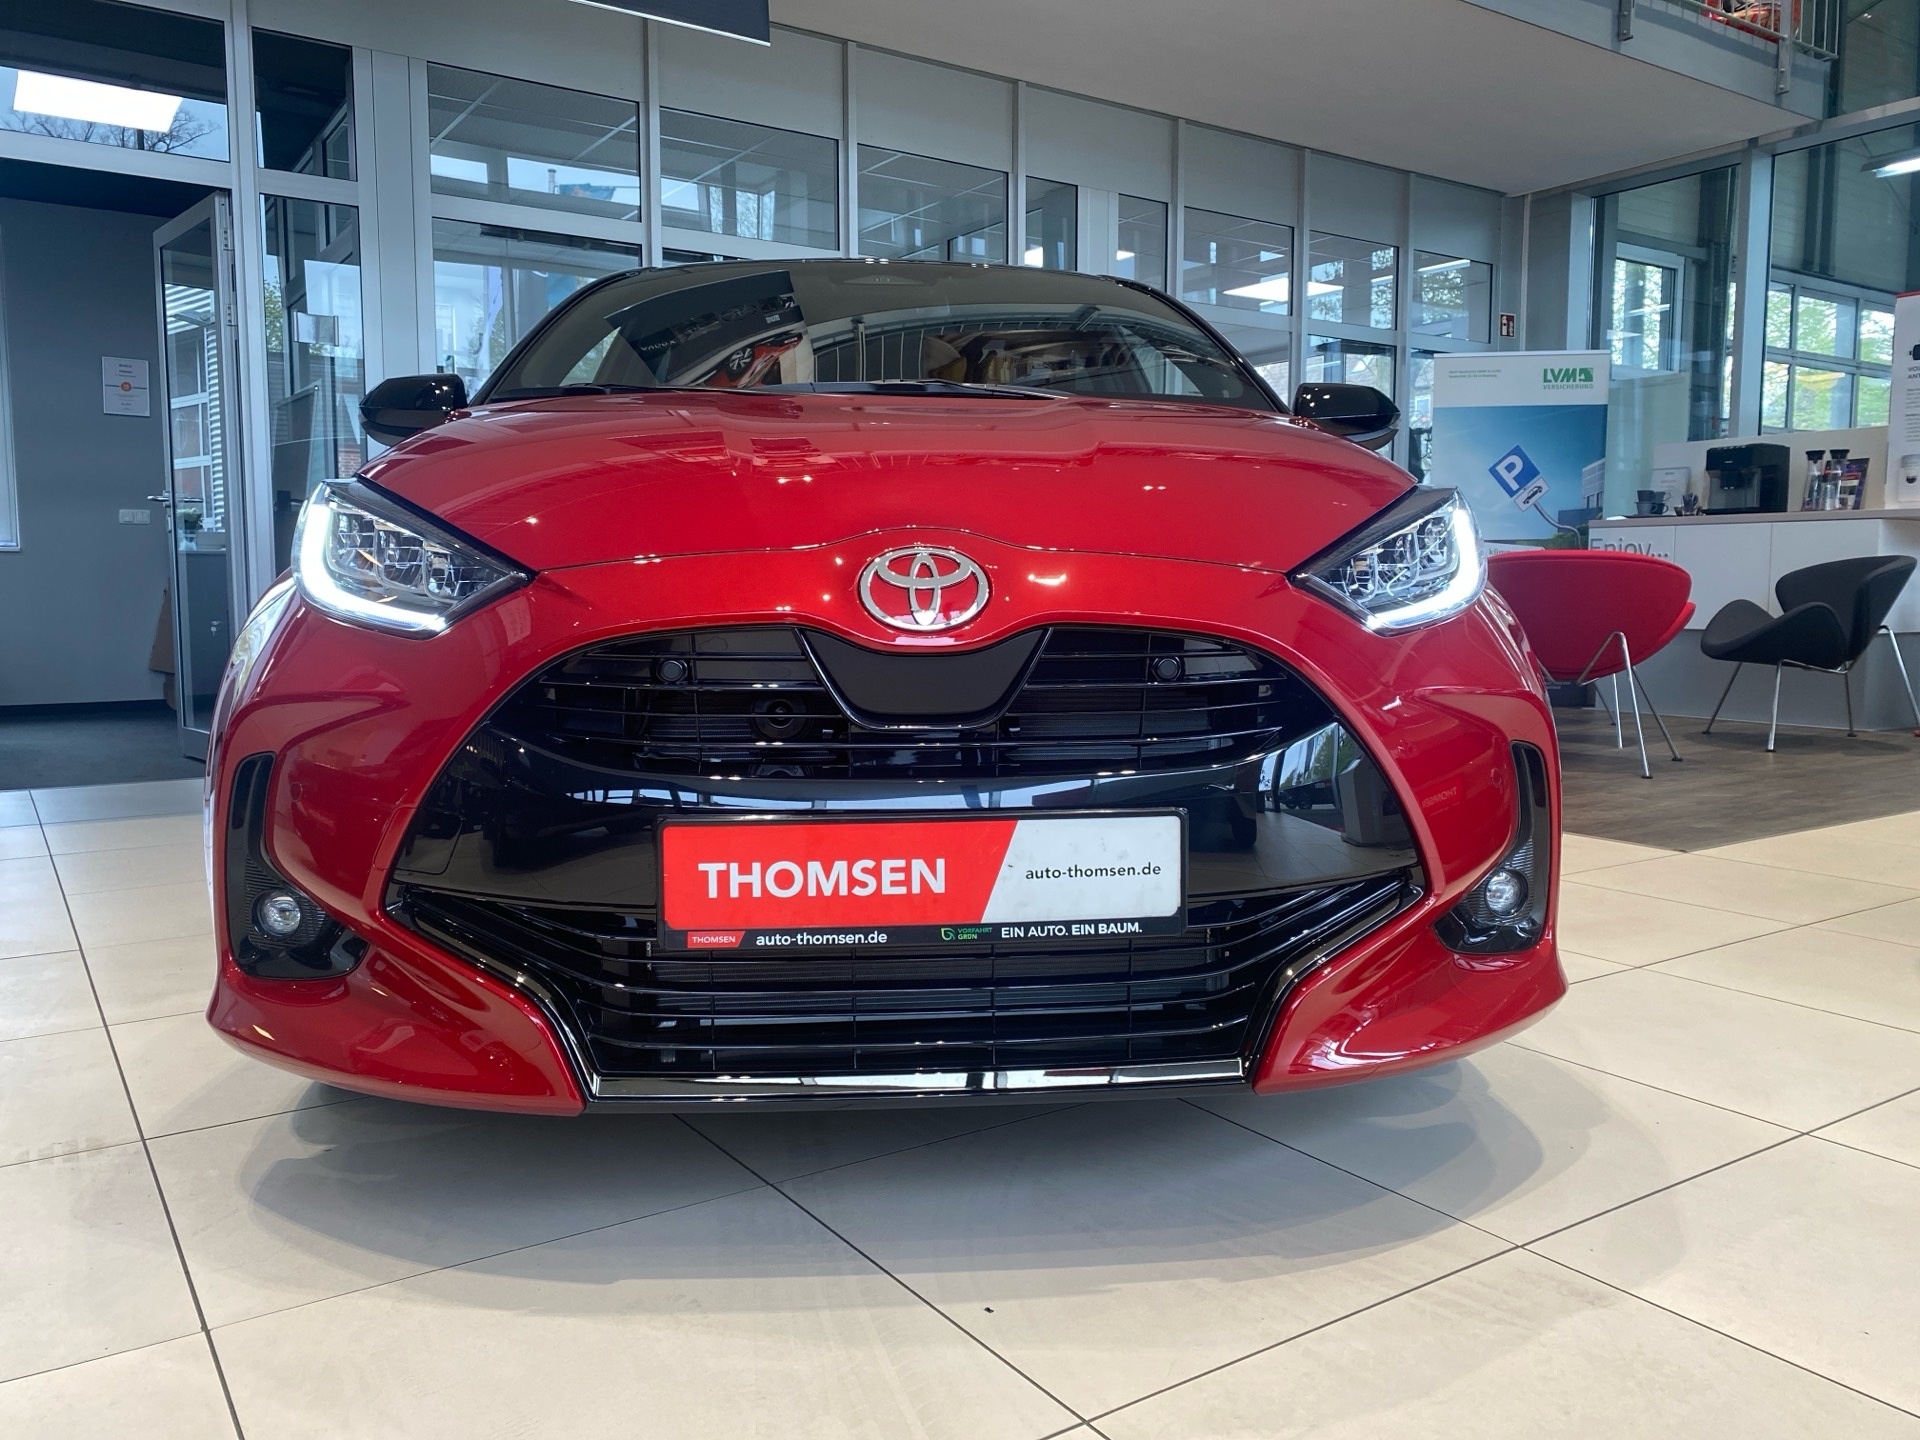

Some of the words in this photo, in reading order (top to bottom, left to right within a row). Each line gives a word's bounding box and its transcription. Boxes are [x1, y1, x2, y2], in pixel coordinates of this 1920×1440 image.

[1543, 367, 1578, 383] LVM
[1496, 454, 1524, 491] P
[1025, 861, 1161, 879] auto-thomsen.de
[697, 858, 946, 899] THOMSEN
[755, 930, 888, 946] auto-thomsen.de
[1001, 926, 1024, 938] EIN
[1027, 924, 1069, 937] AUTO.
[1071, 923, 1095, 936] EIN
[1098, 922, 1143, 934] BAUM.
[691, 936, 736, 944] THOMSEN
